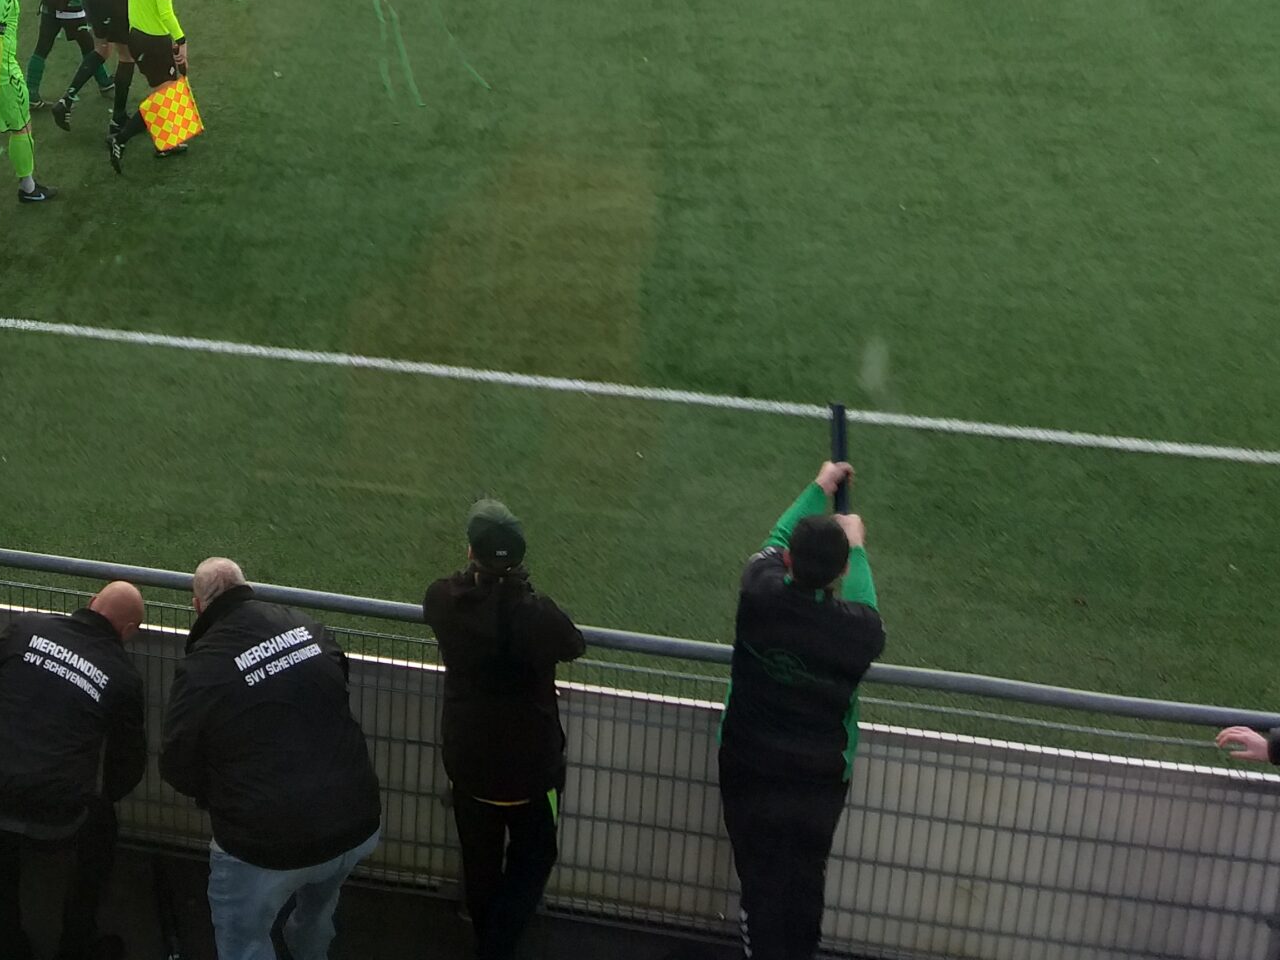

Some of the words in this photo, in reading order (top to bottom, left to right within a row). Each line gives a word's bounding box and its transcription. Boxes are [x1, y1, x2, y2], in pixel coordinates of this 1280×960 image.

[29, 634, 109, 690] MERCHANDISE
[234, 625, 313, 672] MERCHANDISE
[245, 666, 265, 688] SVV
[265, 642, 322, 676] SCHEVENINGEN
[23, 651, 43, 670] SVV
[43, 658, 101, 703] SCHEVENINGEN
